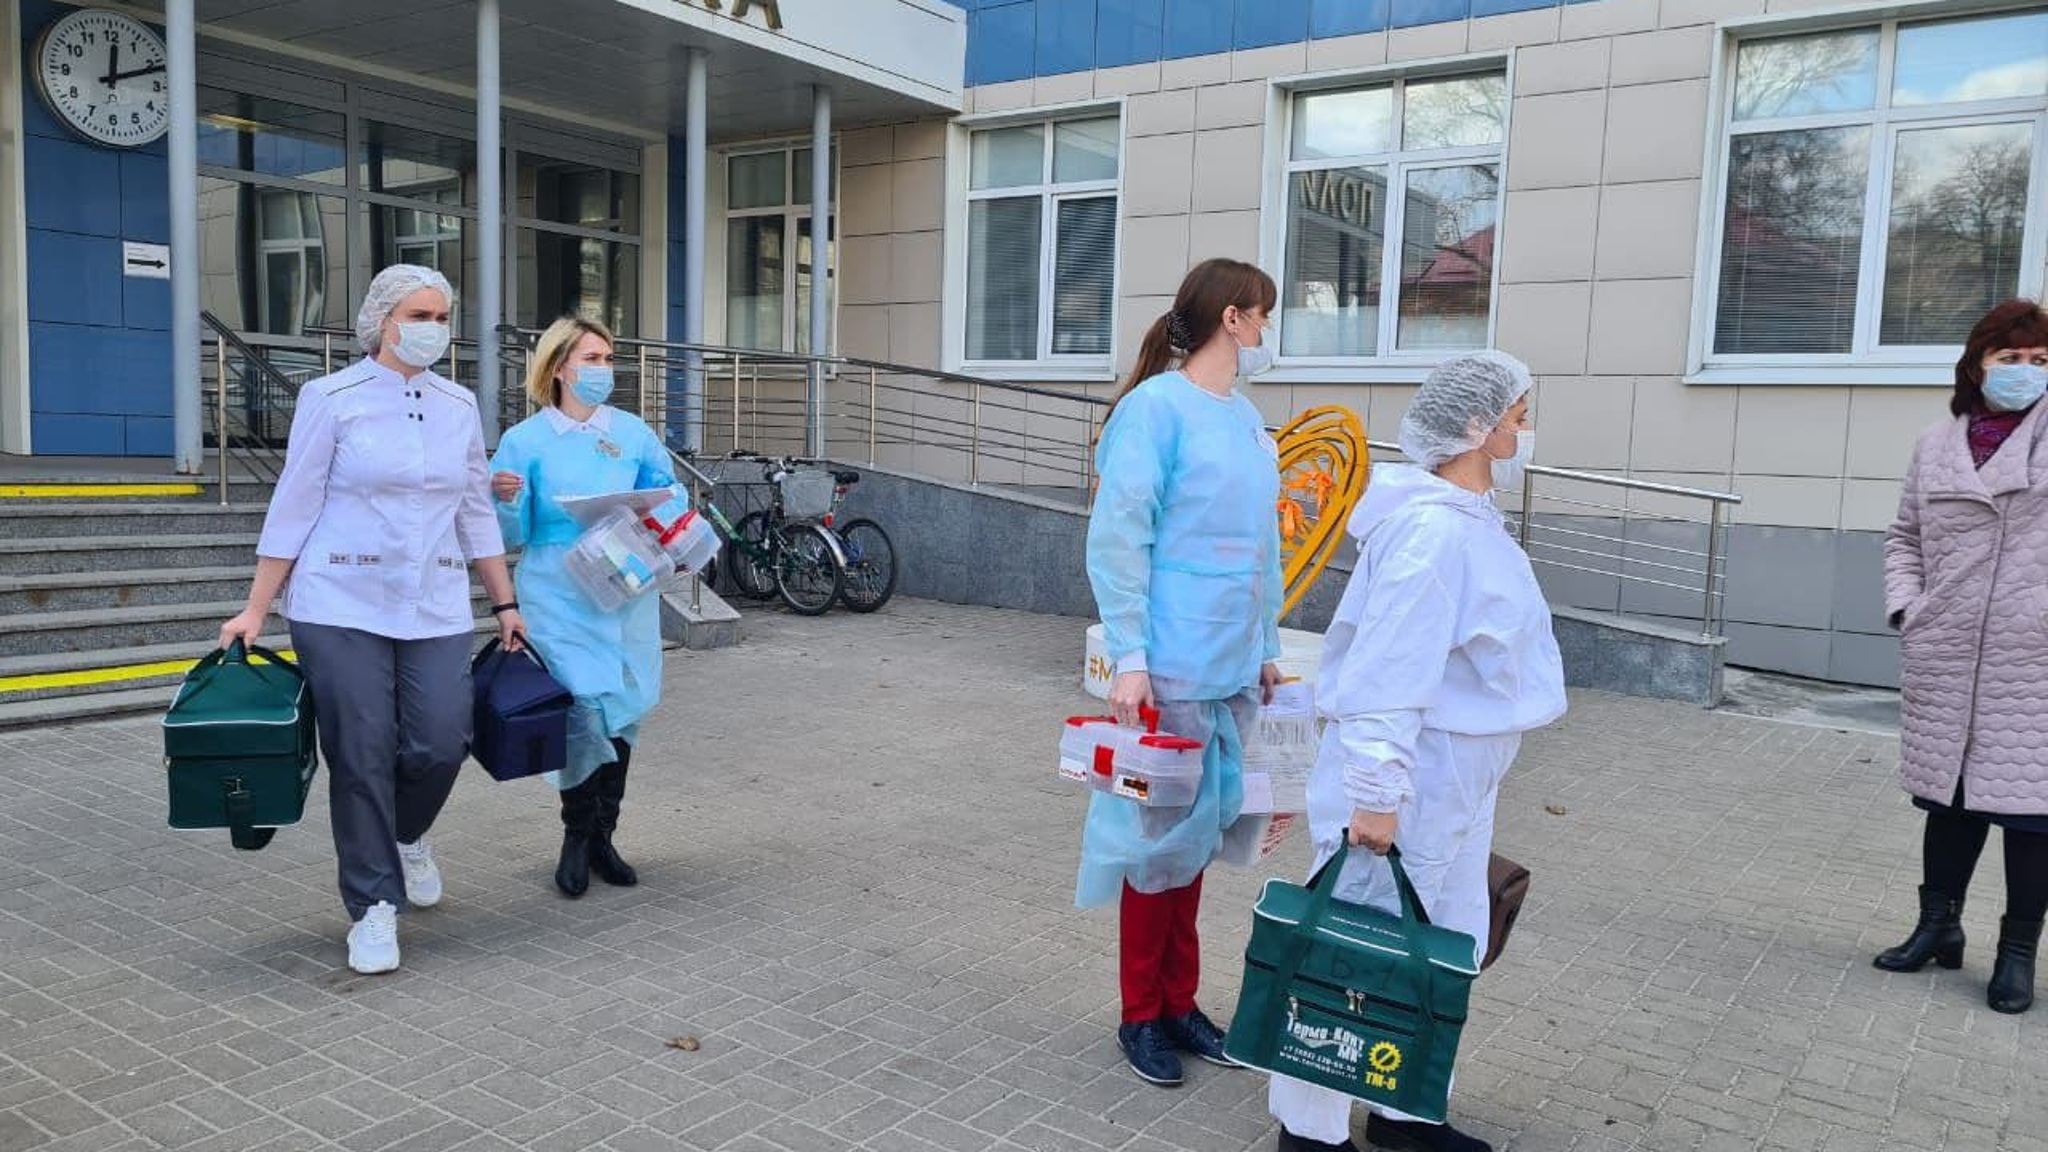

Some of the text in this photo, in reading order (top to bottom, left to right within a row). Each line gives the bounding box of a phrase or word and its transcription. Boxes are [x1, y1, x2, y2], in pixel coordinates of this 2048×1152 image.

[81, 31, 94, 45] 11
[104, 29, 119, 44] 12
[67, 44, 83, 57] 10
[131, 41, 137, 54] 1
[61, 63, 70, 76] 9
[69, 86, 78, 98] 8
[153, 80, 161, 92] 3
[88, 104, 96, 117] 7
[146, 100, 154, 111] 4
[109, 114, 118, 126] 6
[131, 112, 140, 124] 5
